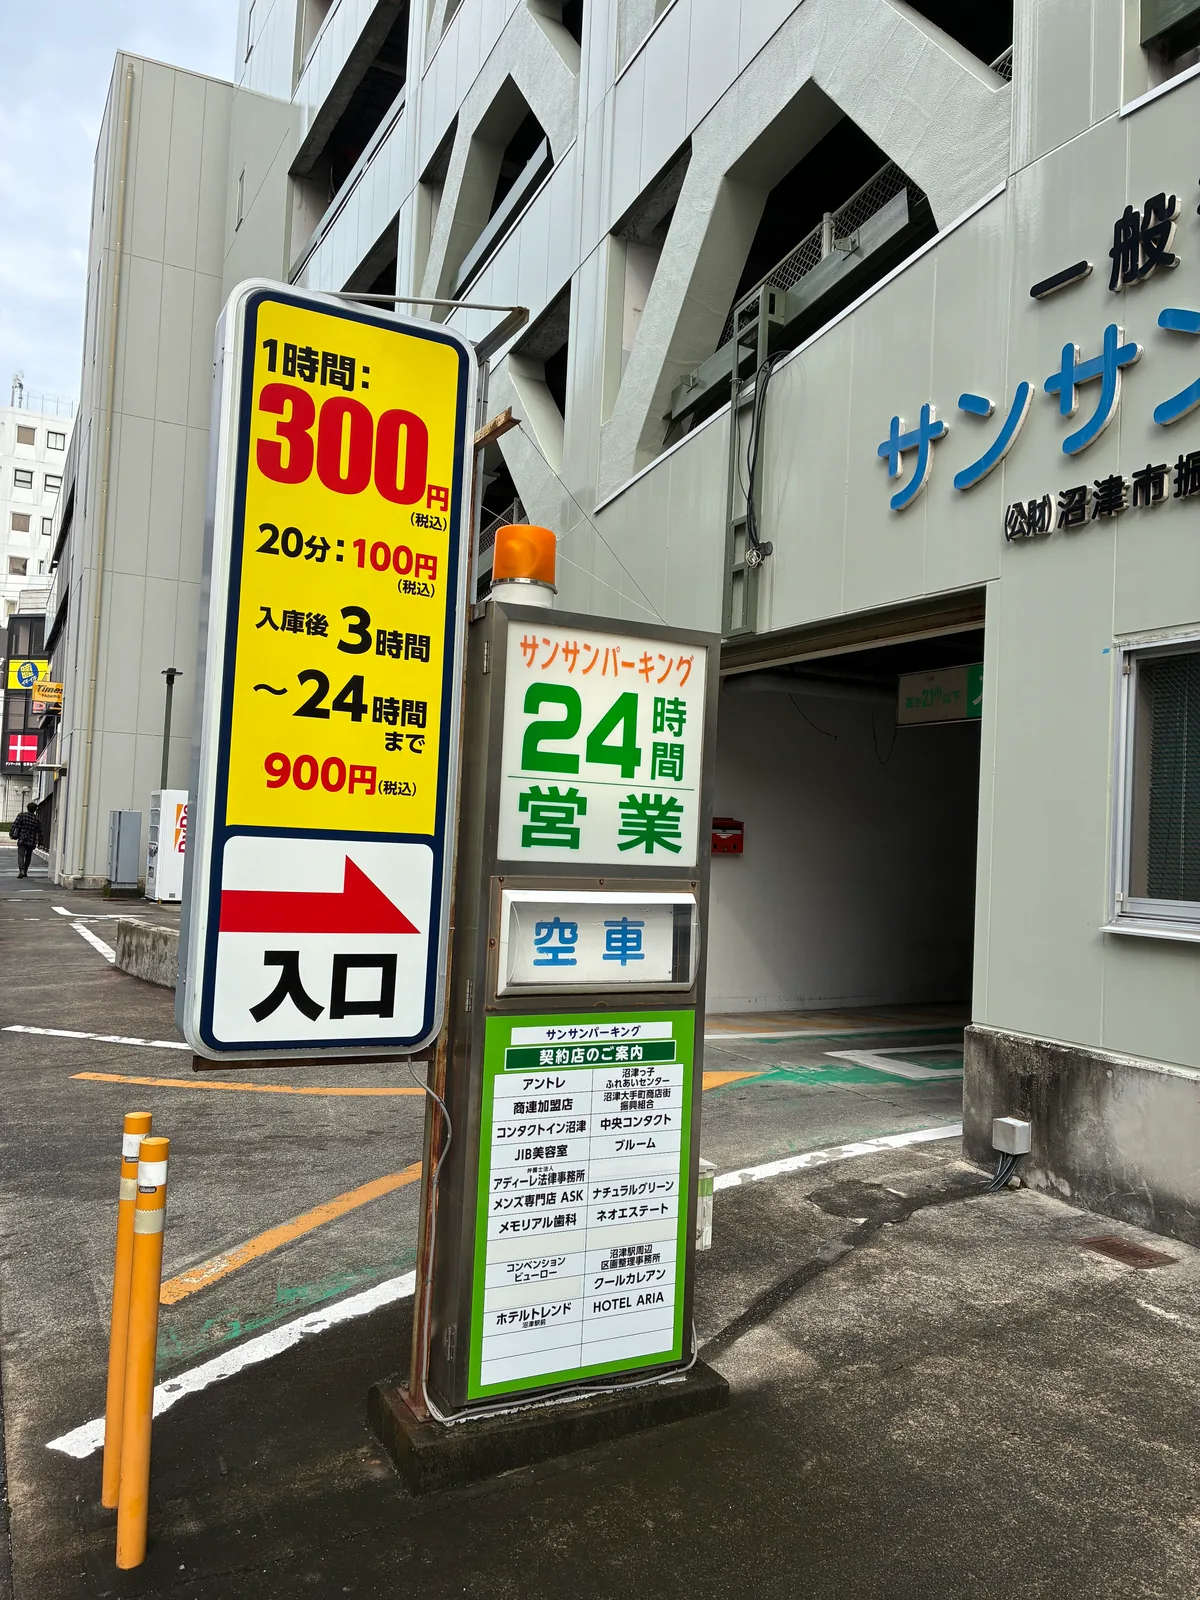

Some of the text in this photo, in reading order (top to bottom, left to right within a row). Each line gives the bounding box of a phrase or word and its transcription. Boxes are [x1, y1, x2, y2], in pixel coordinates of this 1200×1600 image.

[1029, 178, 1200, 297] 一般
[256, 382, 449, 513] 300円
[410, 511, 447, 533] (税込)
[397, 577, 435, 598] (税込)
[519, 634, 695, 688] サンサンパーキング
[384, 731, 426, 755] まで
[517, 785, 685, 854] 営業
[532, 916, 646, 967] 空車
[248, 950, 398, 1024] 入口
[545, 1024, 642, 1041] サンサンパーキング
[539, 1044, 644, 1066] 契約店のご案内
[621, 1067, 655, 1078] 沼津っ子
[522, 1078, 566, 1091] アントレ
[605, 1077, 670, 1089] ふれあいセンター
[603, 1088, 672, 1102] 沼津大手町商店街
[620, 1099, 655, 1111] 振興組合
[513, 1097, 574, 1115] 商連加盟店
[496, 1120, 587, 1139] コンタクトイン沼津
[600, 1113, 672, 1131] 中央コンタクト
[514, 1144, 568, 1161] JIB美容室
[614, 1137, 656, 1152] ブルーム
[493, 1168, 585, 1190] アディーレ法律事務所
[493, 1189, 584, 1211] メンズ専門店 ASK
[592, 1180, 674, 1200] ナチュラルグリーン
[596, 1203, 669, 1222] ネオエステート
[498, 1212, 577, 1234] メモリアル歯科
[609, 1244, 653, 1259] 沼津駅周辺
[506, 1257, 566, 1273] コンベンション
[600, 1253, 661, 1271] 区画整理事務所
[514, 1270, 558, 1283] ビューロー
[593, 1269, 666, 1290] クールカレアン
[593, 1291, 665, 1313] HOTEL ARIA
[496, 1302, 572, 1326] ホテルトレンド
